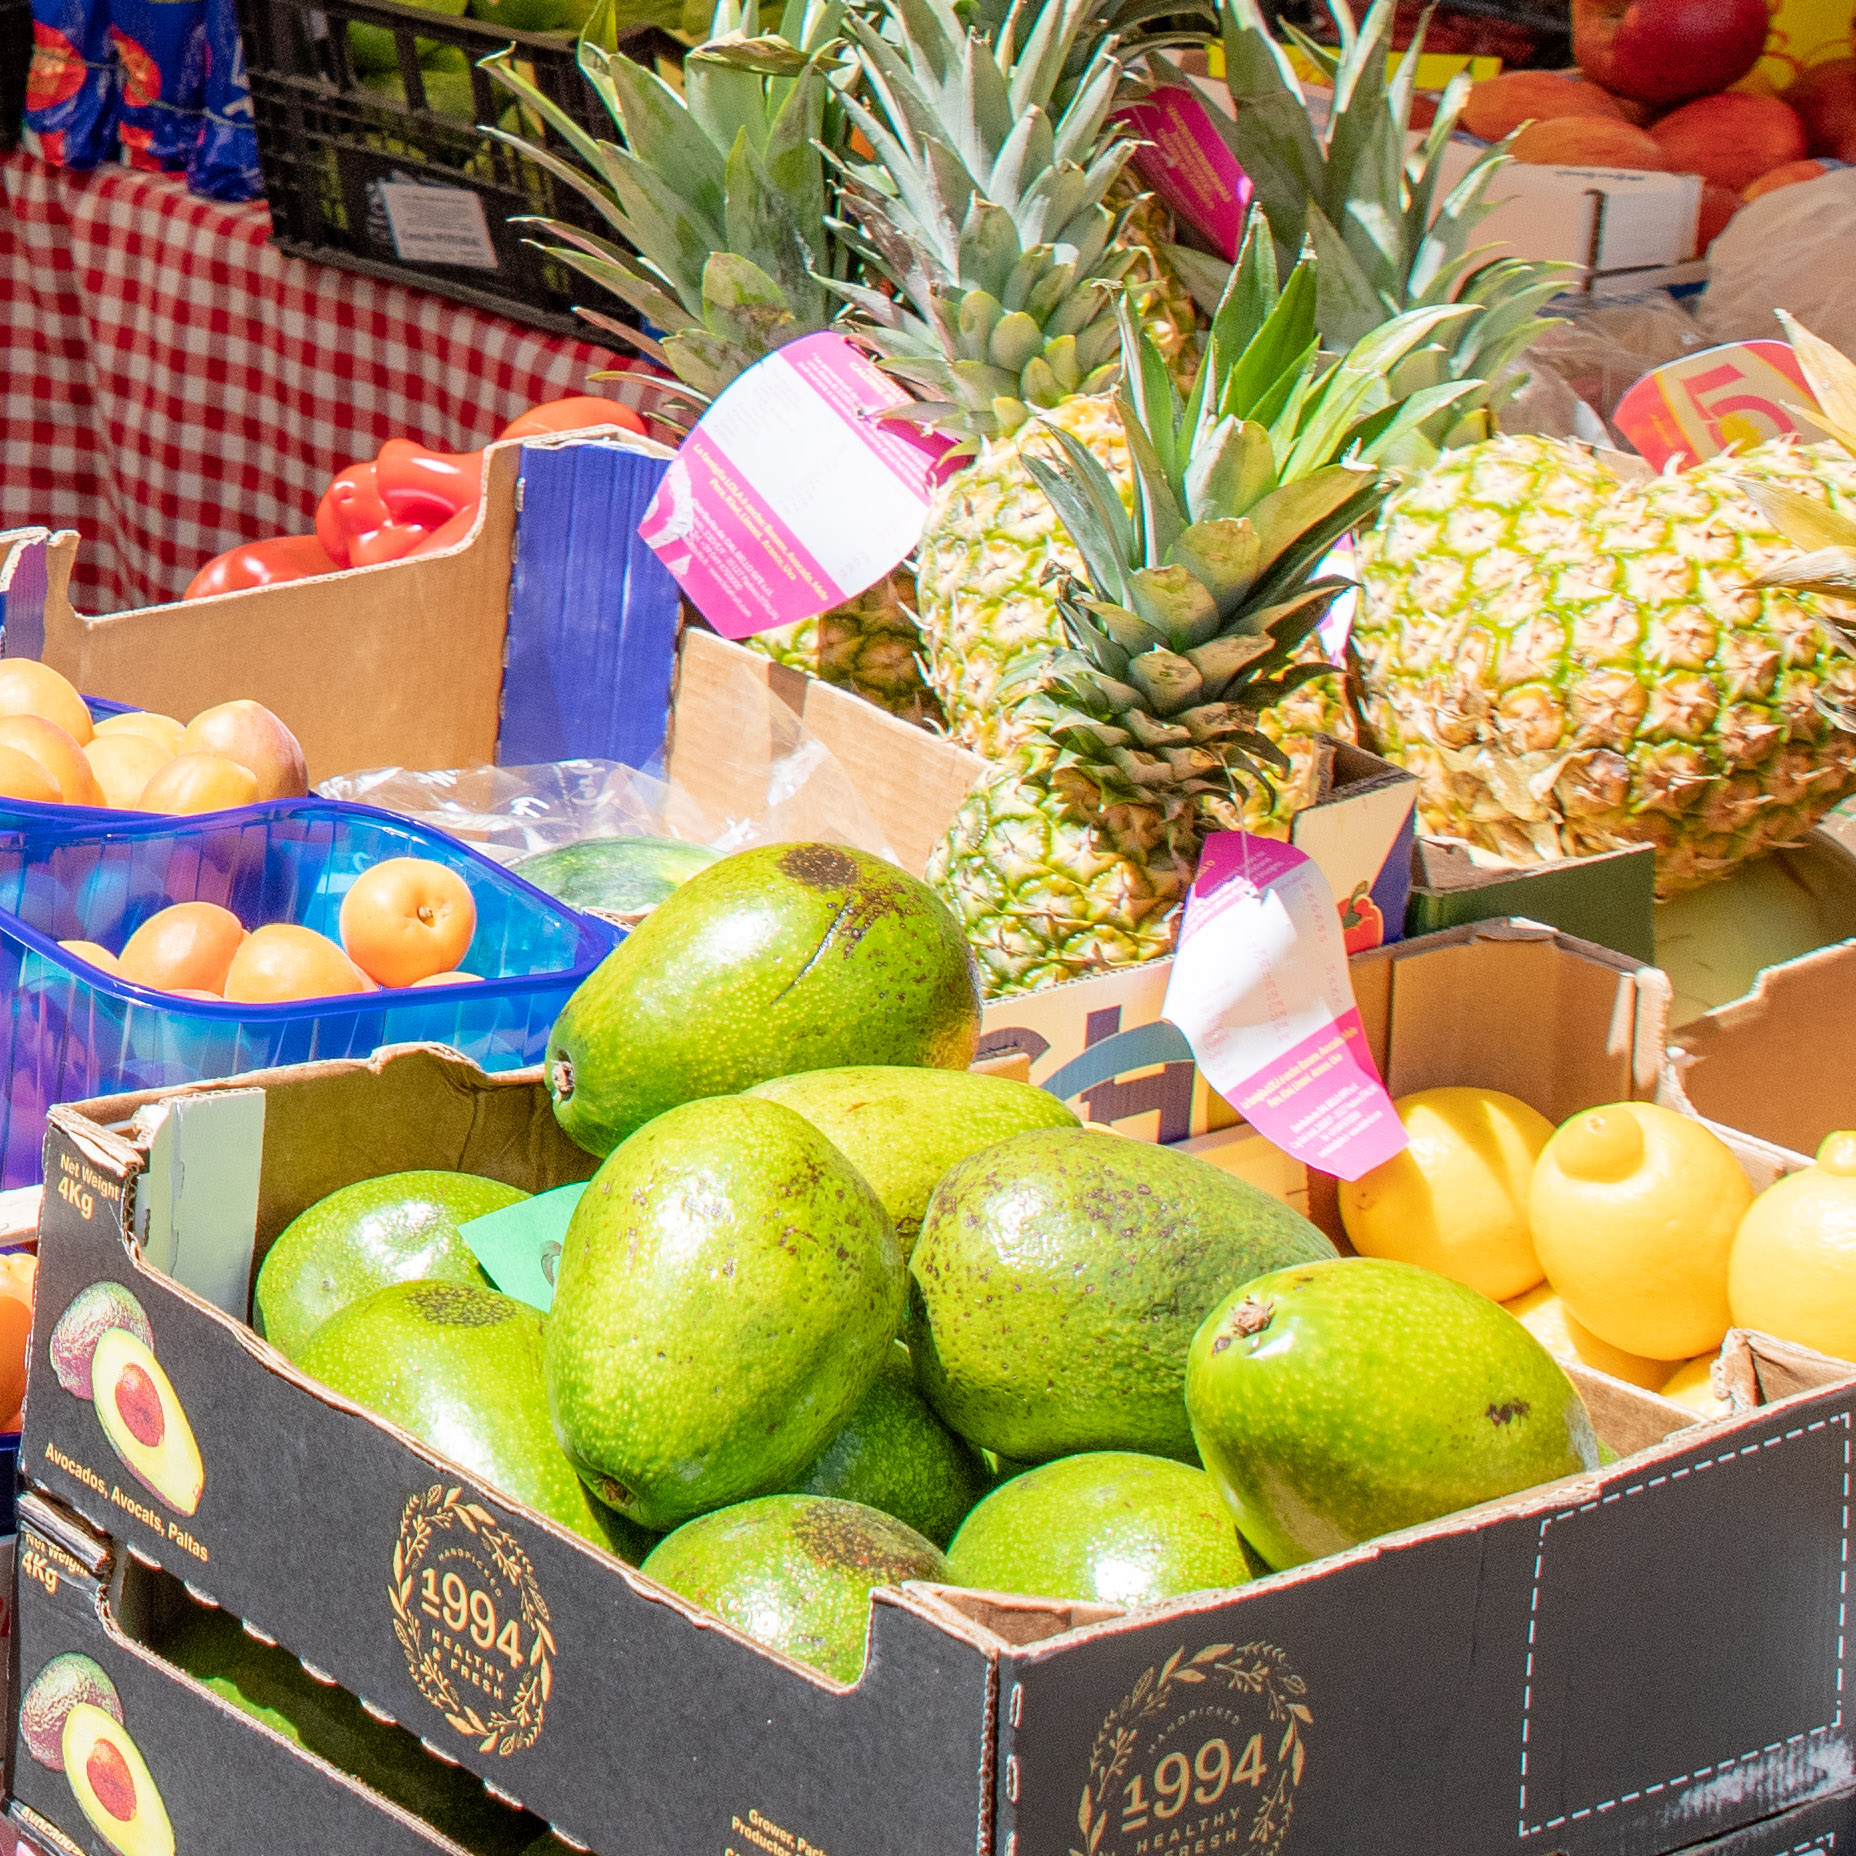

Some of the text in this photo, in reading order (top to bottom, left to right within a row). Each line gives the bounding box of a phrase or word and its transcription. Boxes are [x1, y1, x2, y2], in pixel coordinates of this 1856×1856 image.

[722, 477, 743, 502] LOLA
[57, 1176, 95, 1221] 4Kg
[60, 1153, 122, 1203] Net Weight
[45, 1442, 210, 1564] Avocados, Avocats, Paltas
[22, 1549, 59, 1596] 4Kg
[421, 1567, 525, 1670] 1994
[430, 1627, 506, 1683] HEALTHY
[450, 1656, 503, 1701] FRESH
[1121, 1732, 1268, 1834] 1994
[1137, 1806, 1240, 1854] HEALTHY
